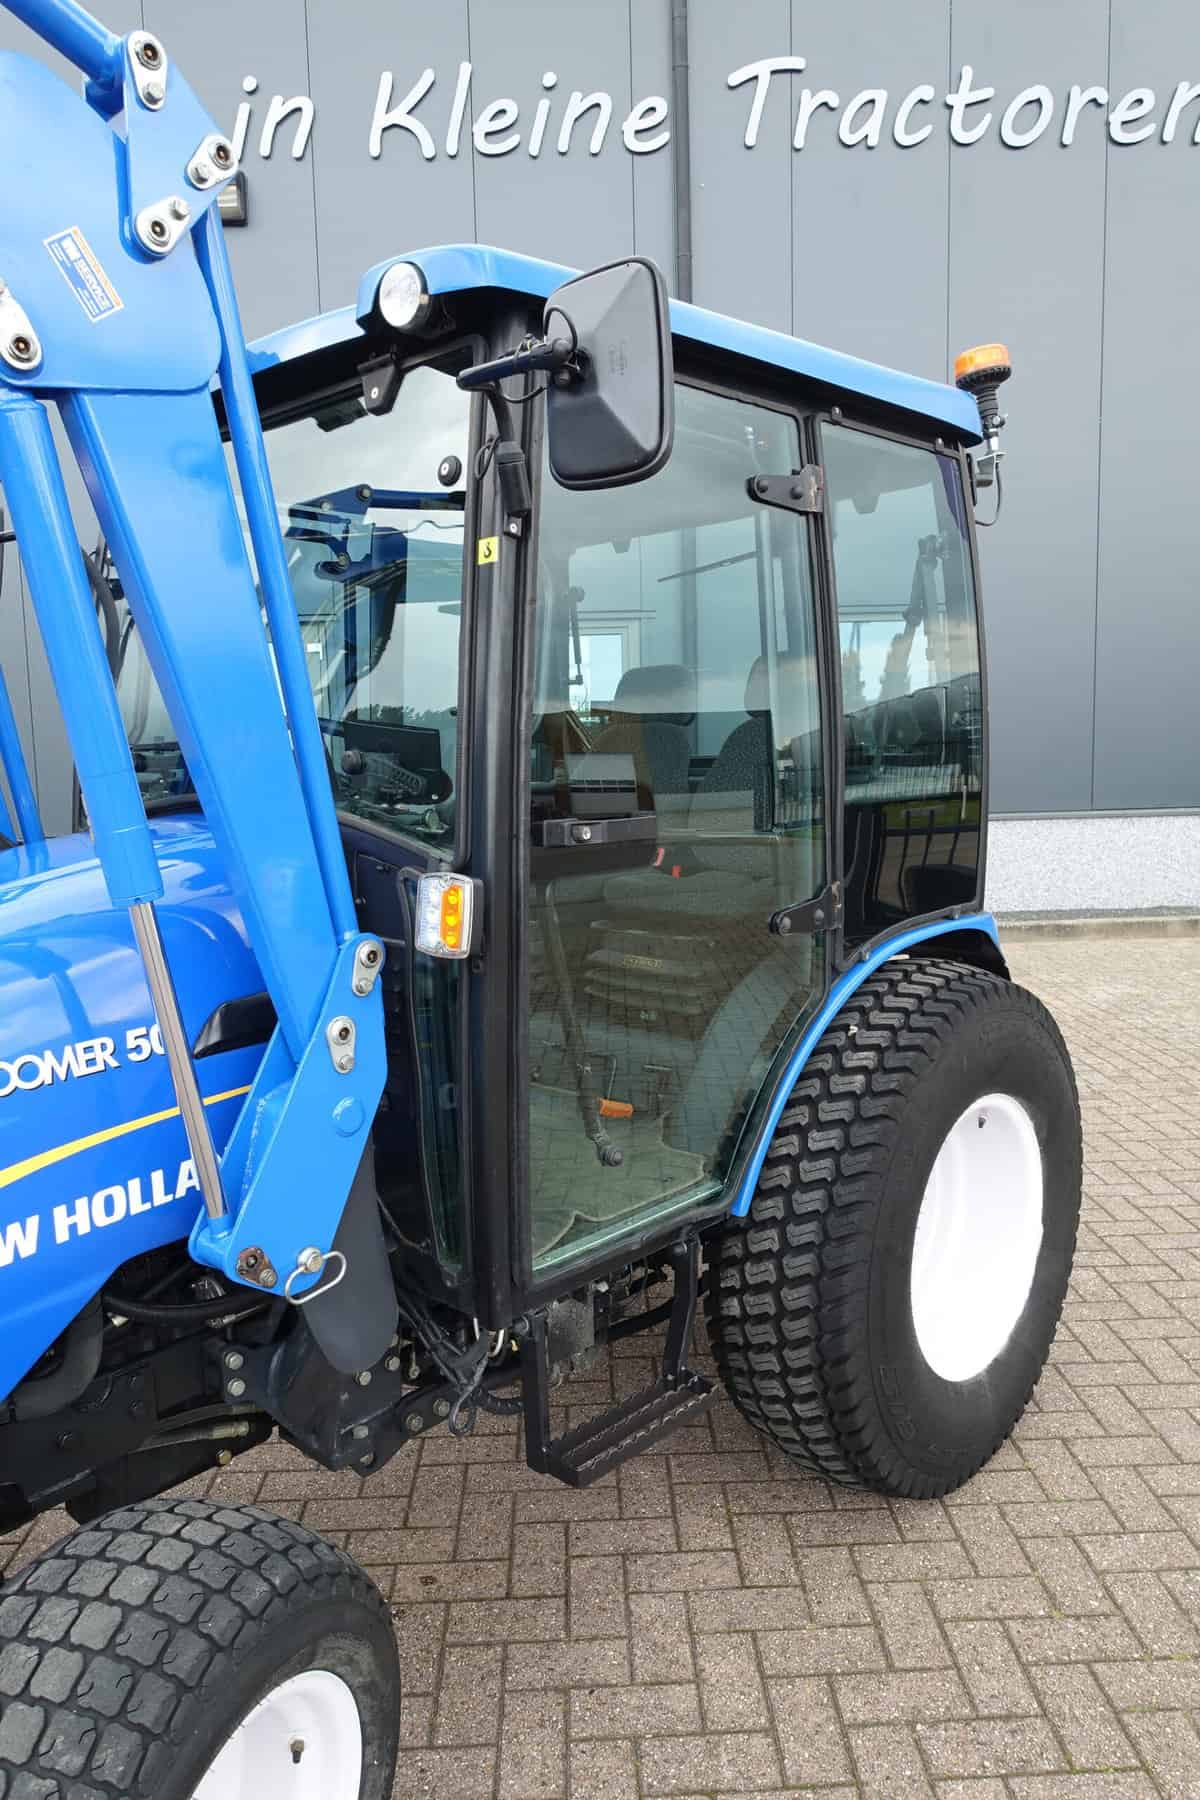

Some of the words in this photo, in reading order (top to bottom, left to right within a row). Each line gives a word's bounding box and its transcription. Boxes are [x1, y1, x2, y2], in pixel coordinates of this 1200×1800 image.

[231, 75, 314, 160] in
[368, 61, 670, 158] Kleine
[727, 56, 1200, 149] Tractoren
